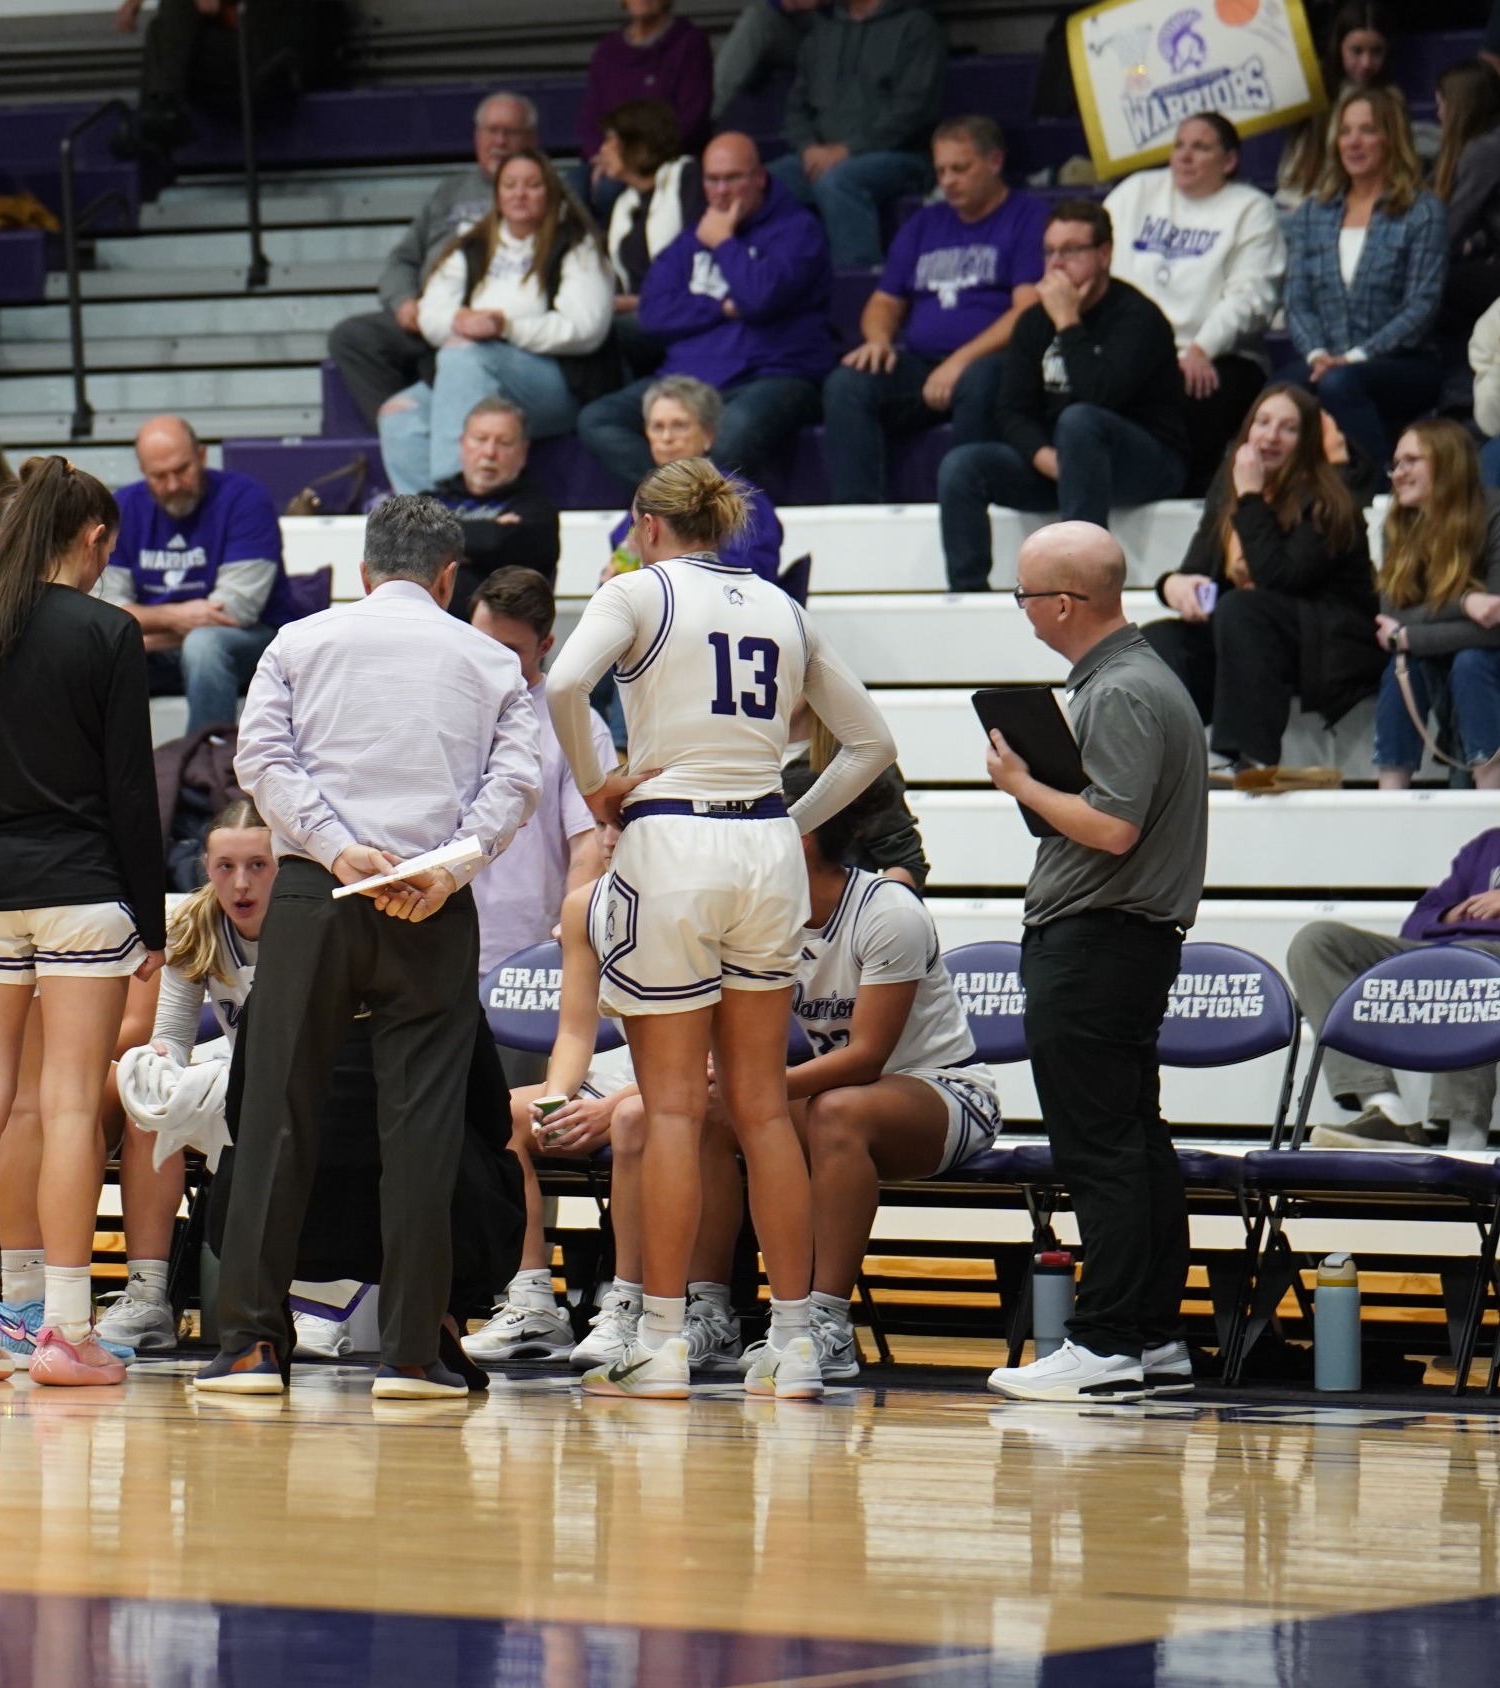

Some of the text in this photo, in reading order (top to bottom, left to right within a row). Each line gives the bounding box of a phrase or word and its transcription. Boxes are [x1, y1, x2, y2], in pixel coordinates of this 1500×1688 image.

[1124, 55, 1273, 148] WARRIORS
[708, 631, 780, 720] 13
[499, 967, 564, 989] GRAD
[952, 972, 1020, 994] ADUA
[1168, 973, 1262, 996] DUATE
[1362, 977, 1500, 1001] GRADUATE
[1163, 994, 1265, 1018] MPIONS
[1352, 999, 1500, 1024] CHAMPIONS
